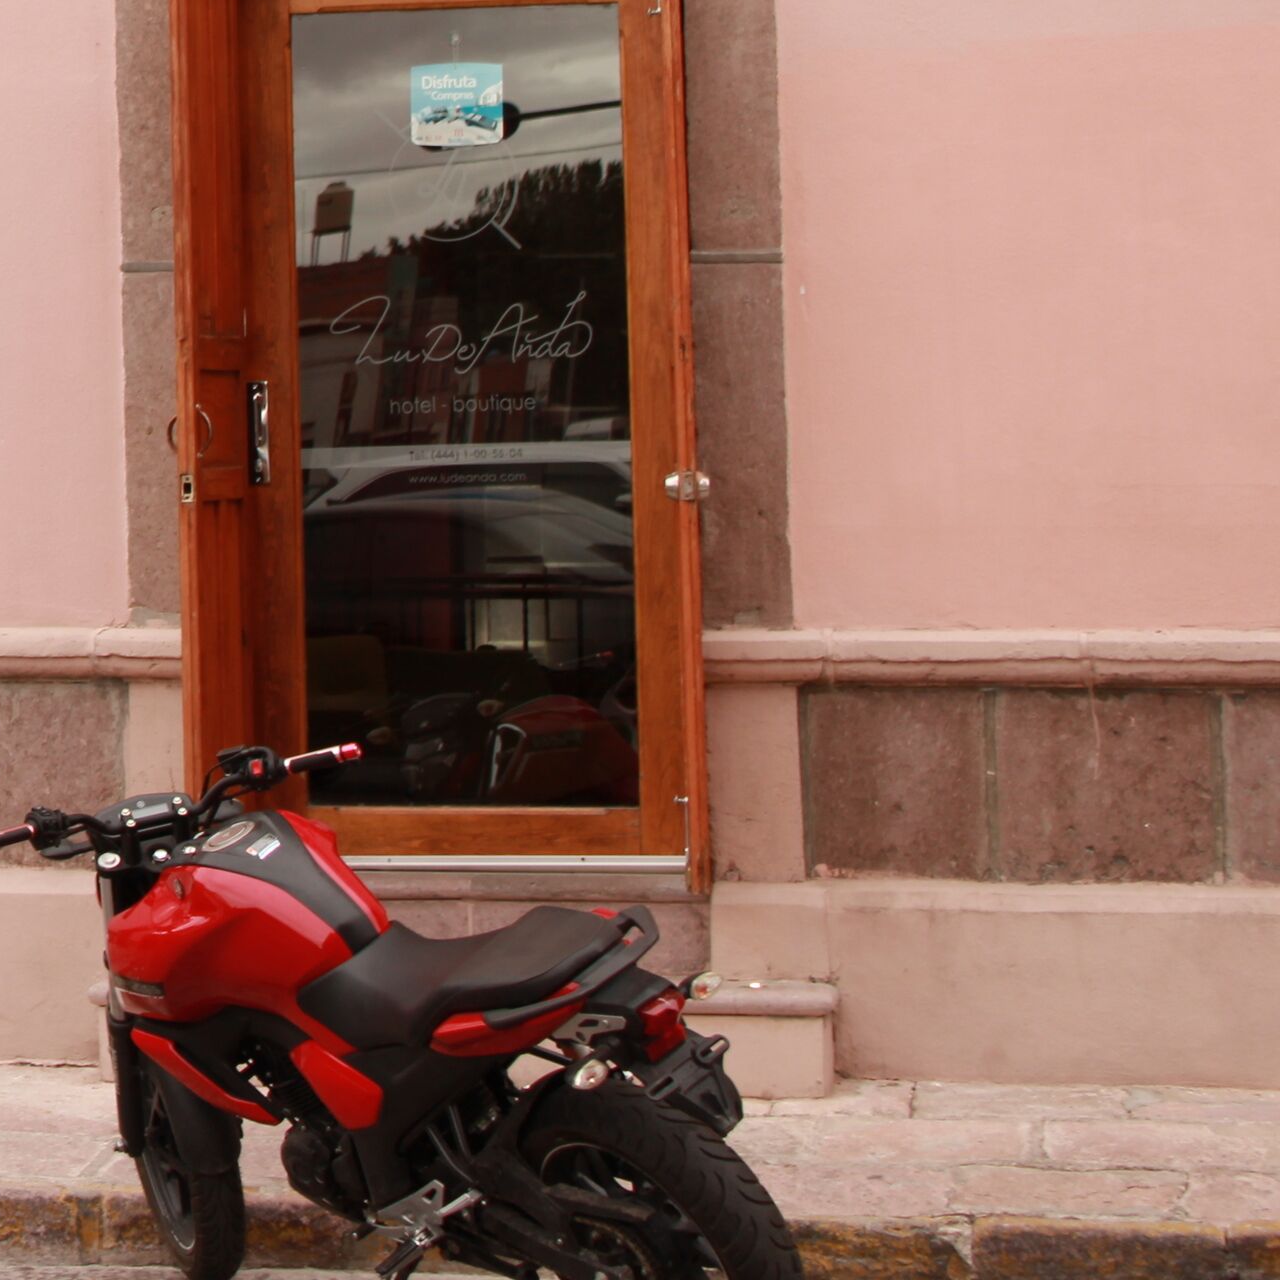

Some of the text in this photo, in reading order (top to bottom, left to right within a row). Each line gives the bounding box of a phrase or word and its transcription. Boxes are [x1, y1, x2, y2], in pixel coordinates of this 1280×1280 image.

[421, 74, 477, 90] Disfruta
[389, 396, 437, 415] hotel
[452, 393, 537, 415] boutique
